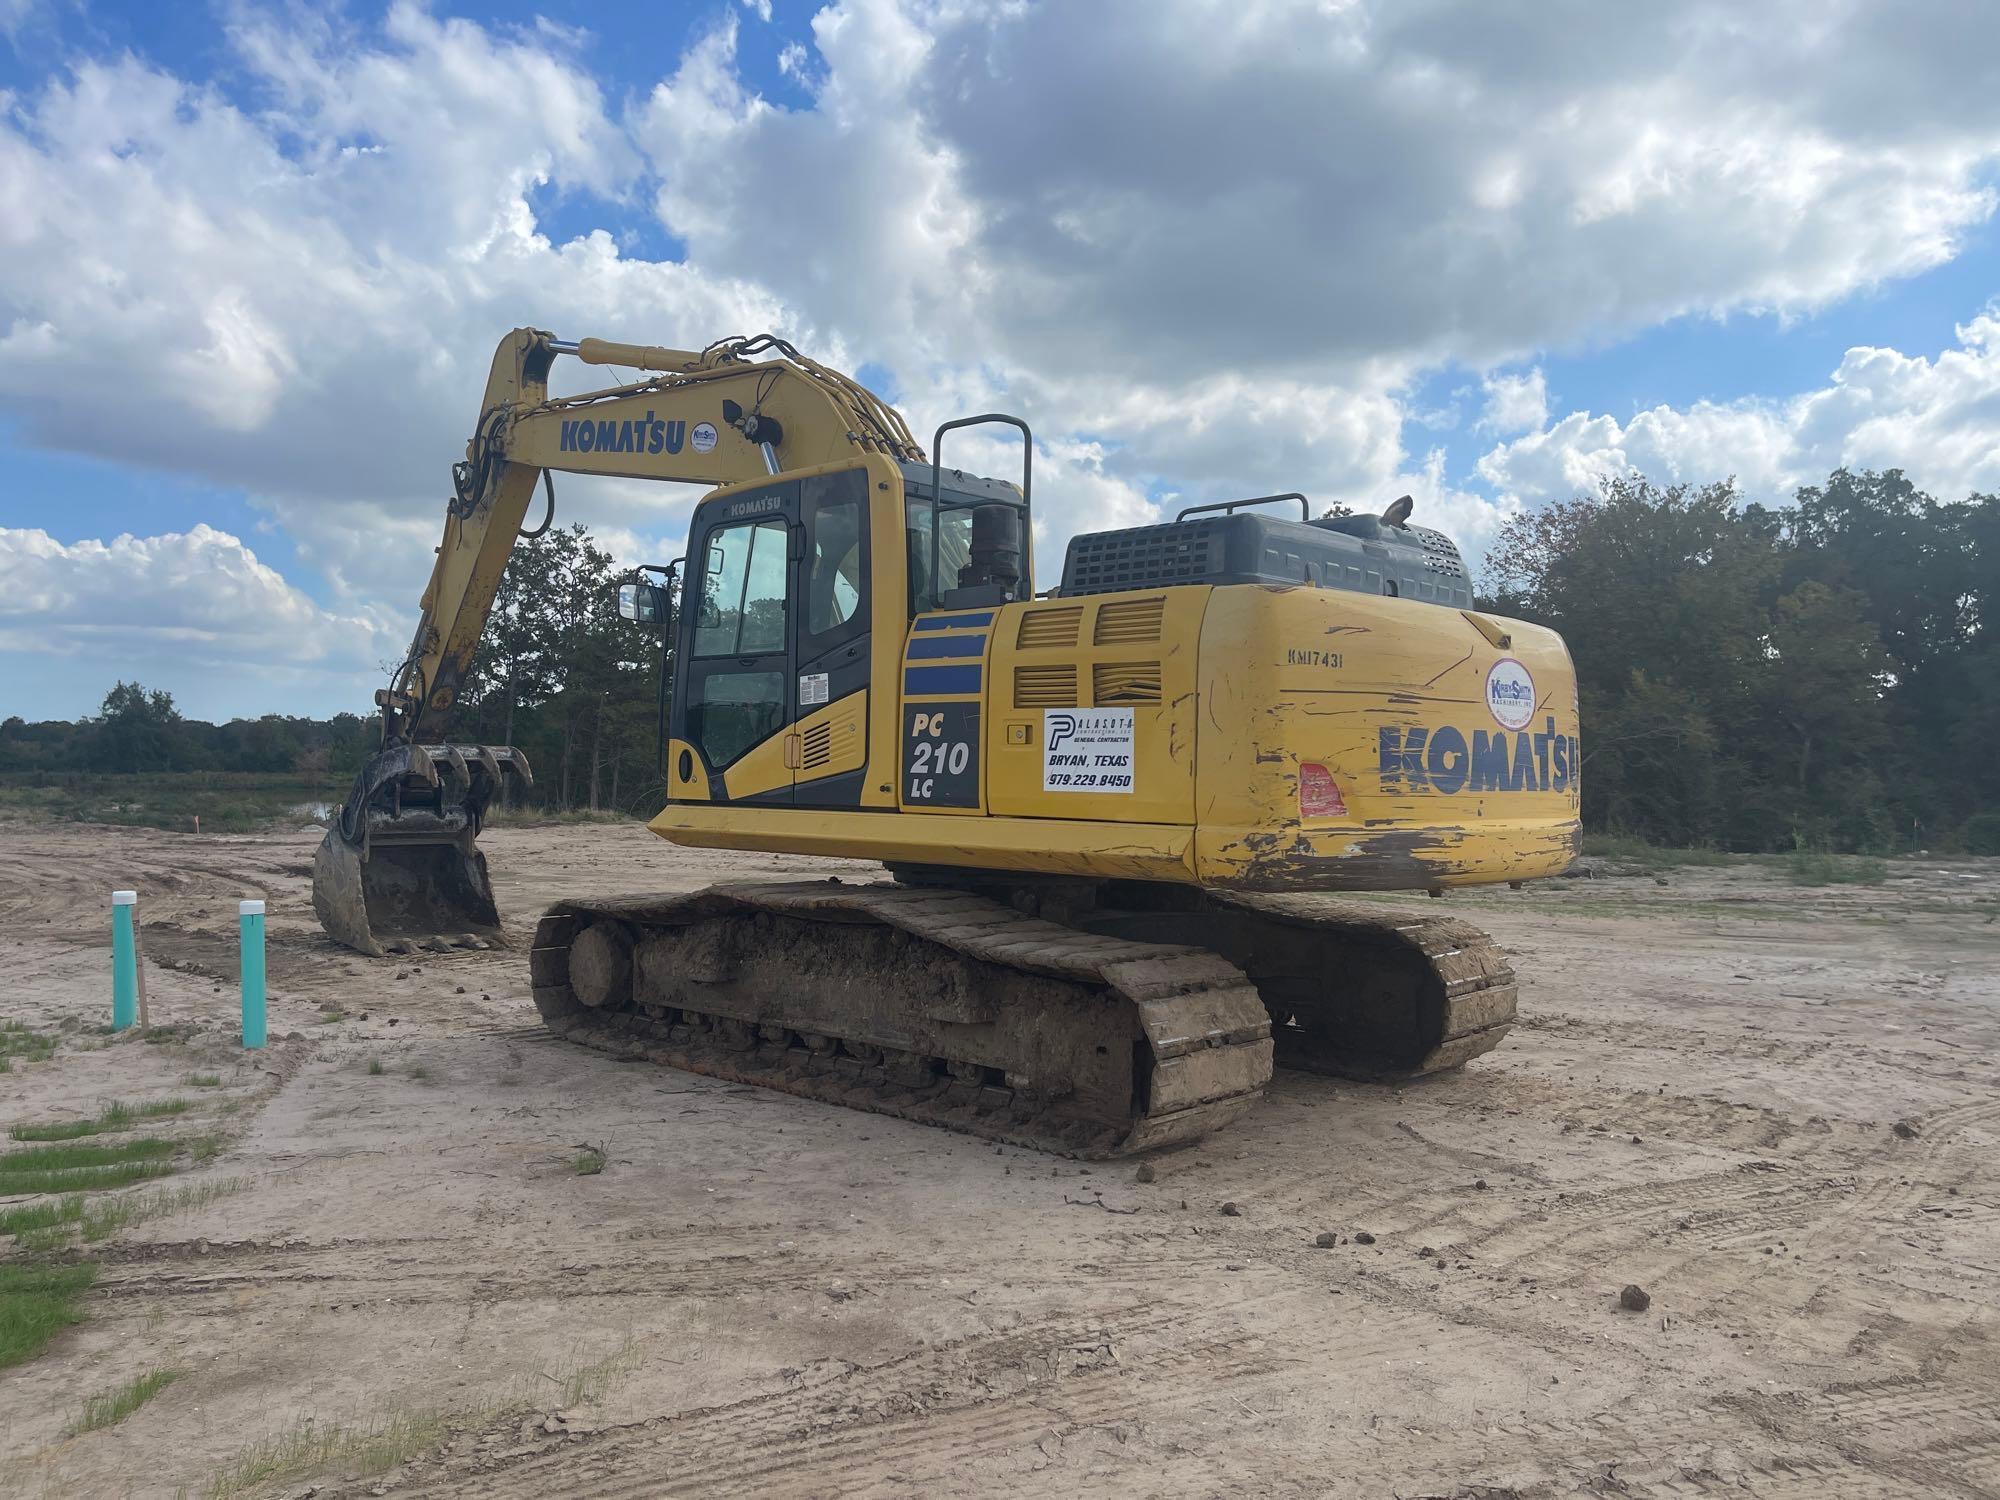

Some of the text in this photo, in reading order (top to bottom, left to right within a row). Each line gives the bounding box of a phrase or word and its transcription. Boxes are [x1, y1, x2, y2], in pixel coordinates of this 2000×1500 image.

[560, 411, 686, 455] KOMATSU
[731, 496, 781, 516] KOMATSU
[912, 712, 945, 737] PC
[909, 742, 969, 775] 210
[1049, 755, 1129, 767] BRYAN, TEXAS
[1379, 716, 1580, 794] KOMATSU
[911, 778, 934, 798] LC
[1049, 773, 1132, 787] 979.229.8450
